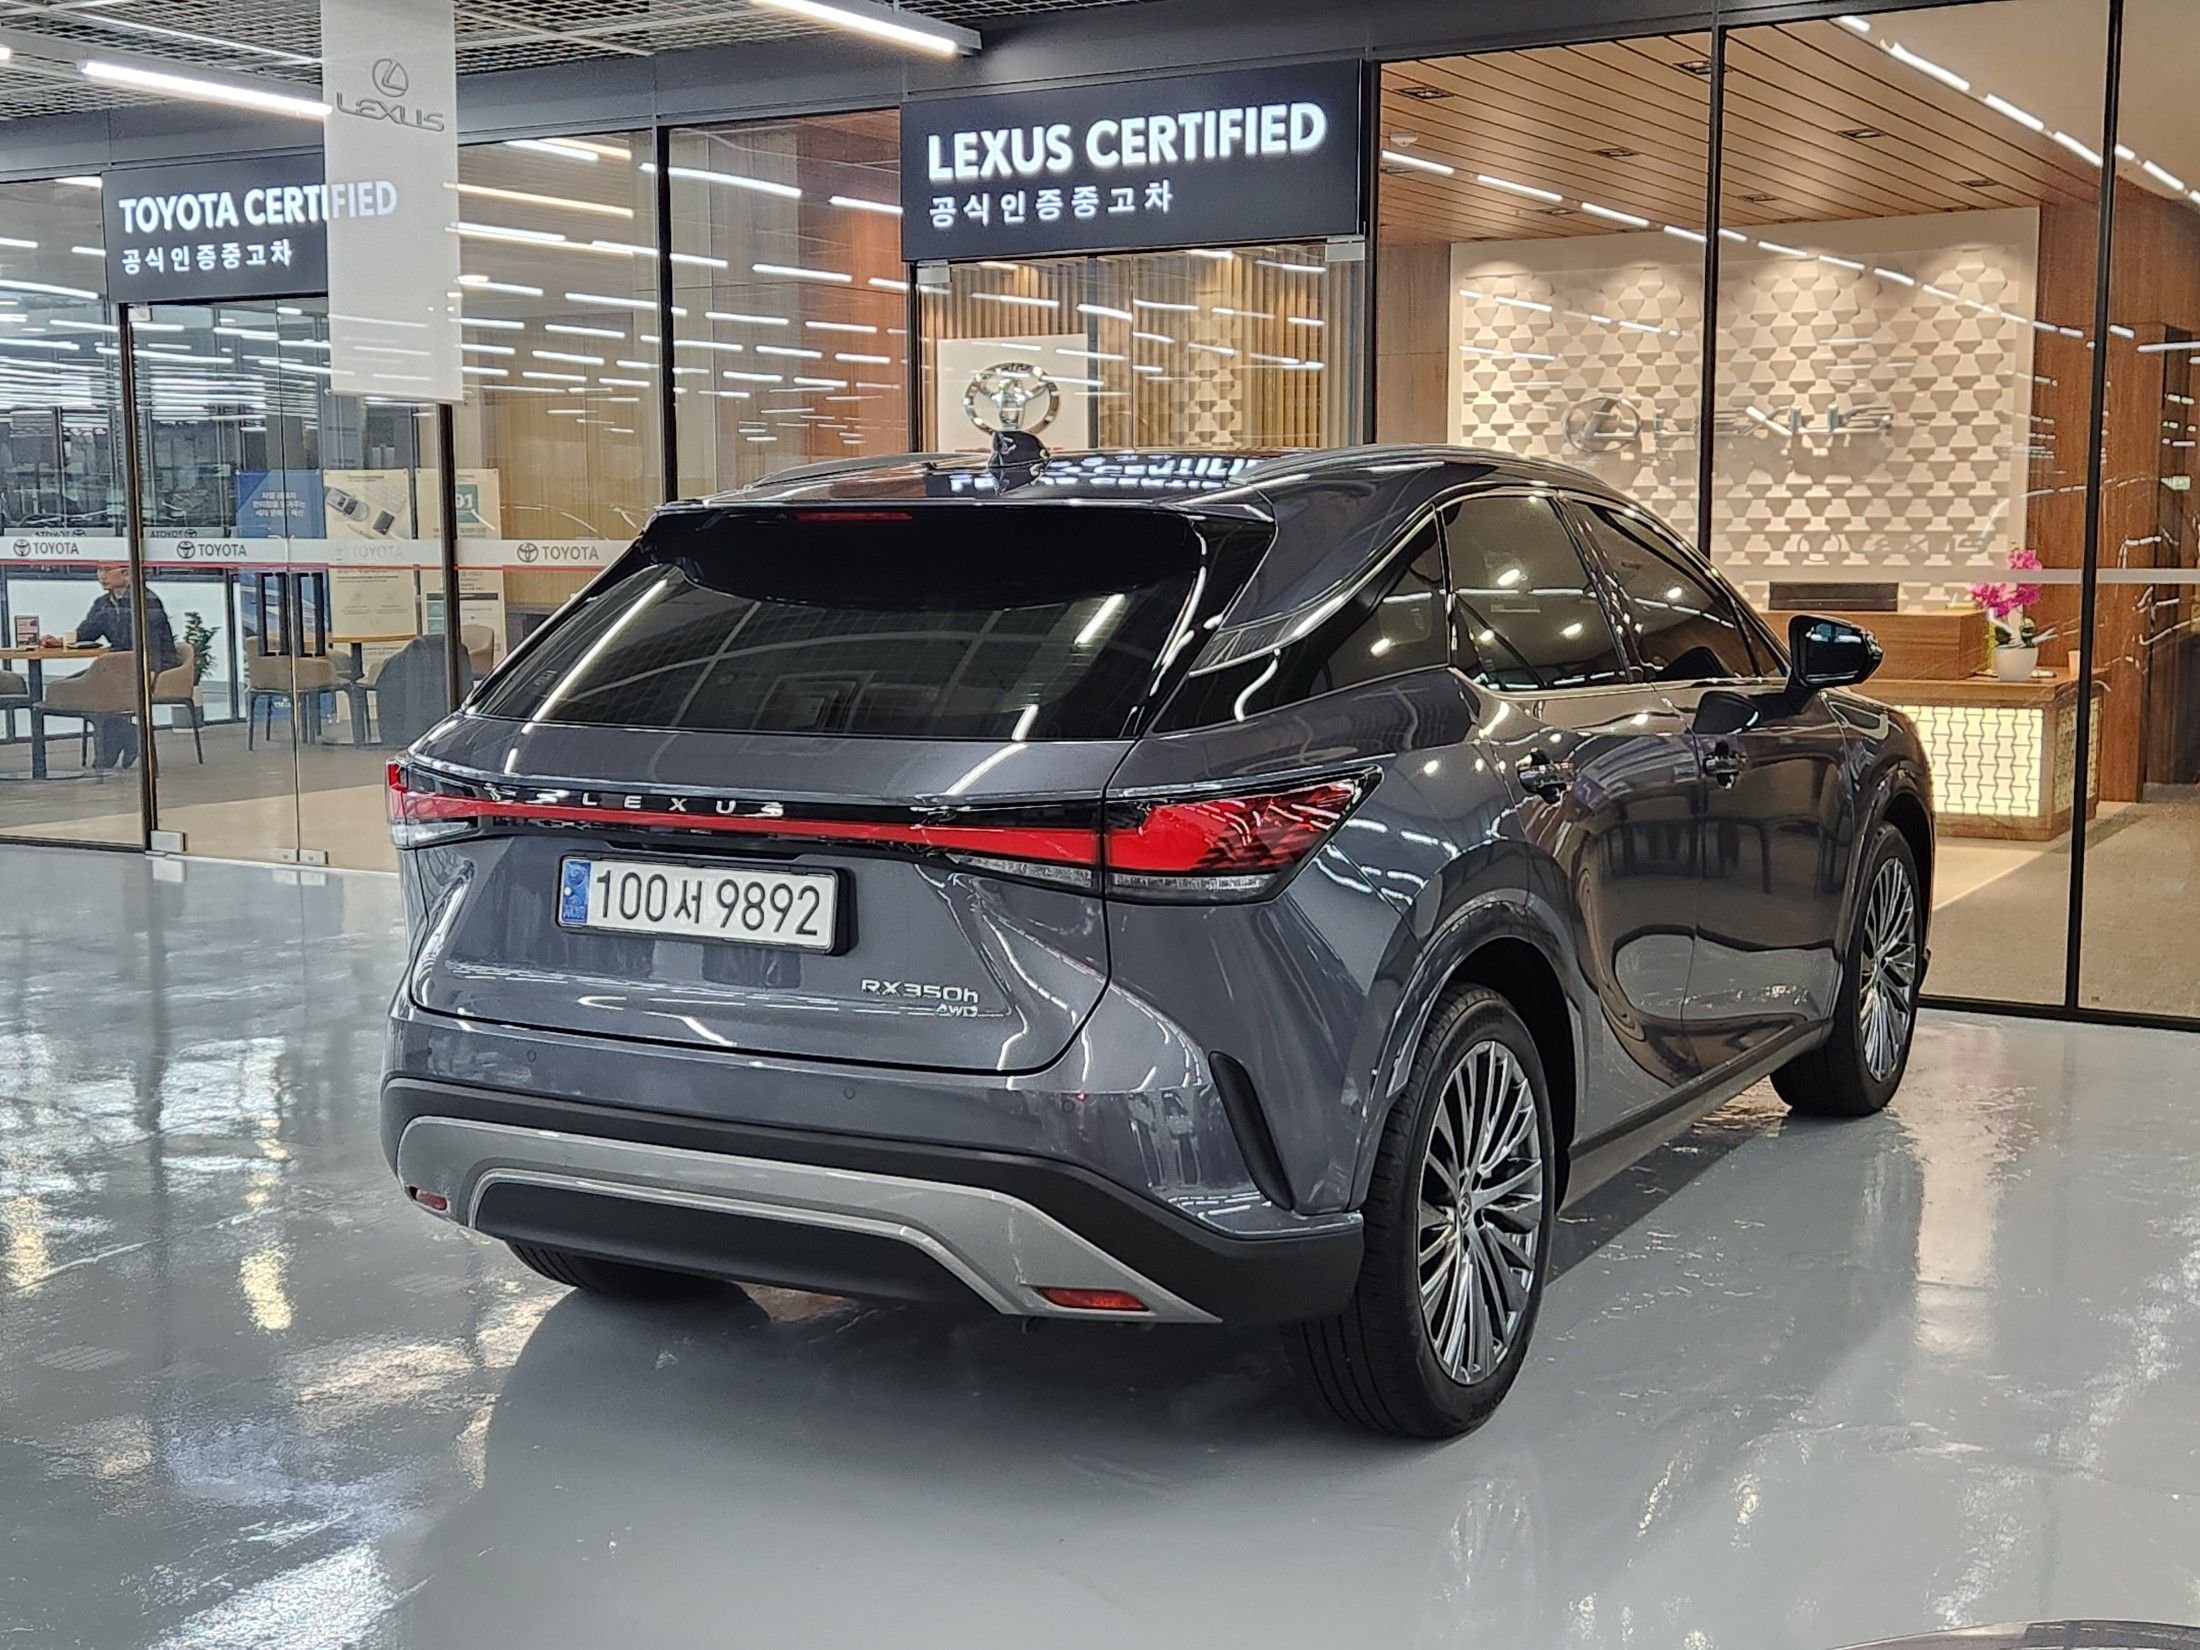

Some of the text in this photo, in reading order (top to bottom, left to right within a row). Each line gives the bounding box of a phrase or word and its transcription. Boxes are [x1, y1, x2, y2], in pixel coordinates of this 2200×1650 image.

[337, 92, 444, 132] LEXUS
[928, 102, 1327, 182] LEXUS CERTIFIED
[119, 181, 398, 233] TOYOTA CERTIFIED
[929, 180, 1172, 228] 공식인증중고차
[122, 238, 293, 275] 공식인증중고차
[33, 542, 79, 555] TOYOTA
[198, 544, 247, 557] TOYOTA
[542, 546, 599, 560] TOYOTA
[583, 796, 783, 817] LEXUS
[936, 1003, 978, 1018] AWD
